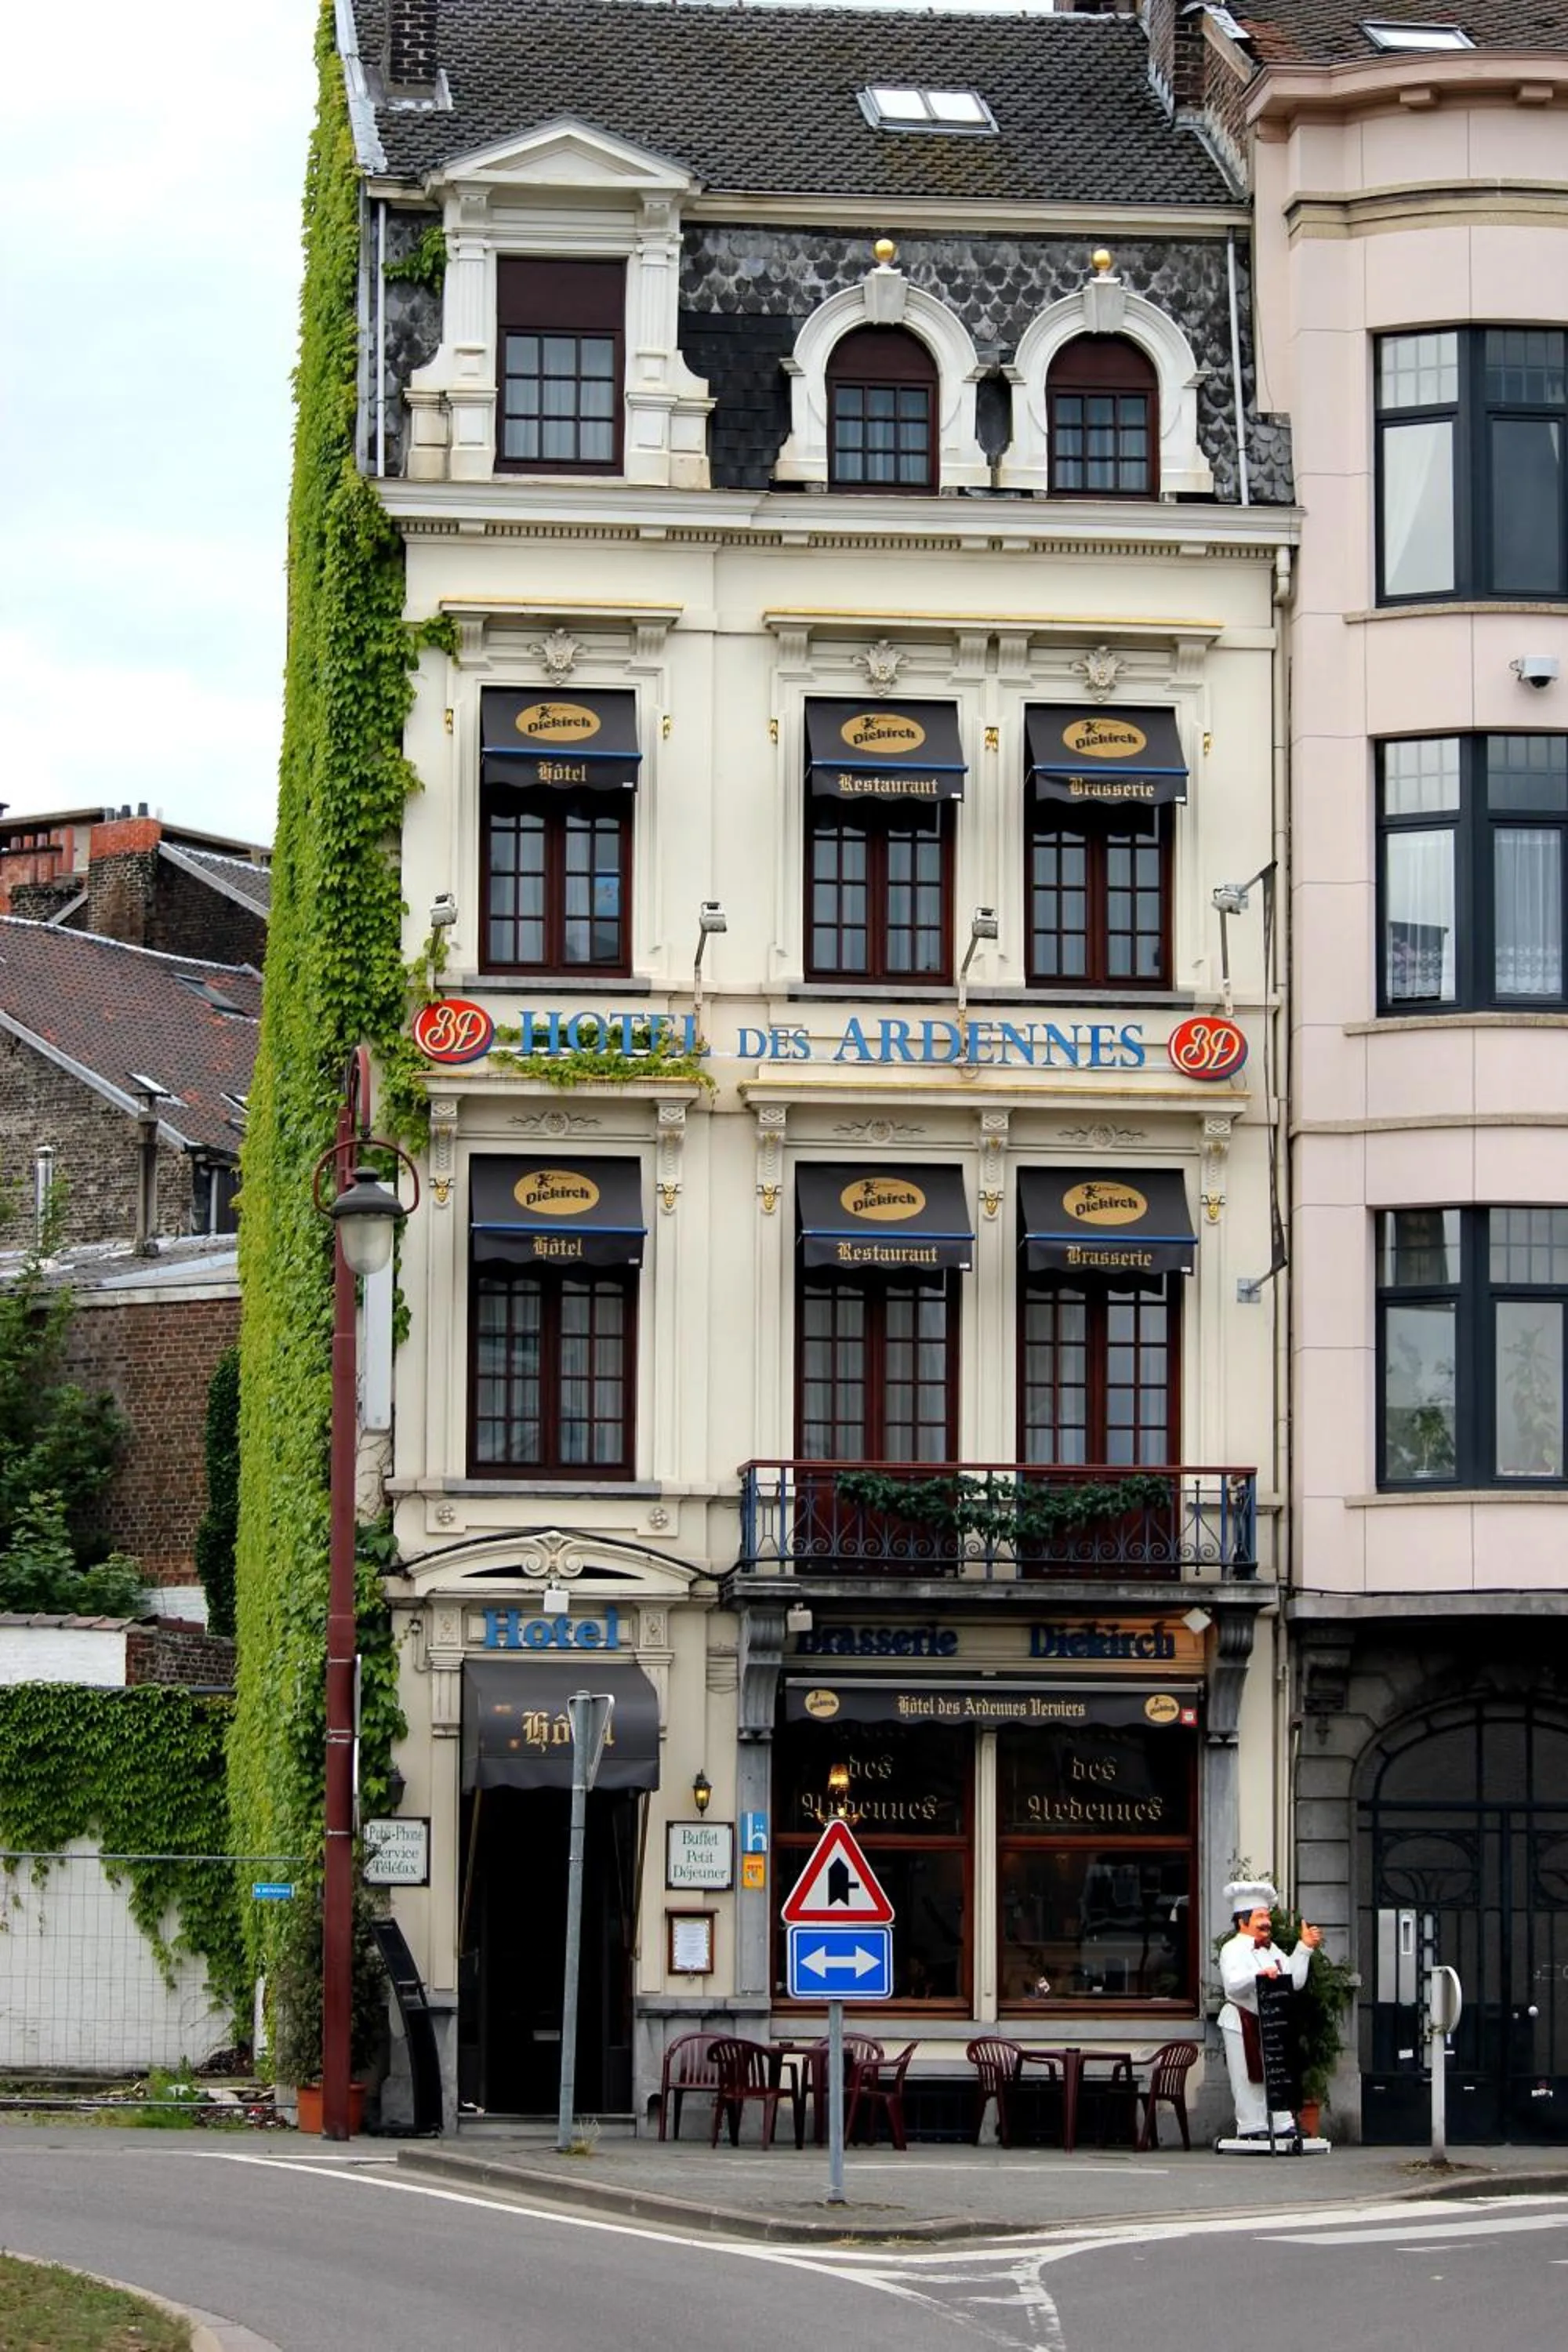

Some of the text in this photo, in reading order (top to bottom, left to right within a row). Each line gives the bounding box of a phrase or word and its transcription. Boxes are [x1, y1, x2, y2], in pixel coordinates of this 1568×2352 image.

[527, 716, 592, 733] Diekirch
[853, 727, 916, 746] Diekirch
[1075, 732, 1138, 750] Diekirch
[537, 761, 586, 785] Hôtel
[839, 773, 938, 794] Restaurant
[1069, 776, 1155, 797] Brasserie
[737, 1028, 811, 1059] DES
[833, 1017, 1145, 1067] ARDENNES
[526, 1186, 590, 1205] Diekirch
[853, 1192, 916, 1212] Diekirch
[1075, 1196, 1138, 1216] Diekirch
[533, 1236, 583, 1260] Hôtel
[837, 1242, 938, 1262] Restaurant
[1066, 1245, 1152, 1266] Brasserie
[484, 1606, 618, 1650] Hotel
[898, 1696, 1086, 1717] Hôtel des Ardennes Verviers
[522, 1711, 615, 1753] Hôl
[1072, 1756, 1116, 1780] des
[1028, 1795, 1163, 1820] Ardennes
[681, 1829, 719, 1846] Buffet
[686, 1849, 713, 1864] Petit
[673, 1864, 728, 1881] Déjeuner
